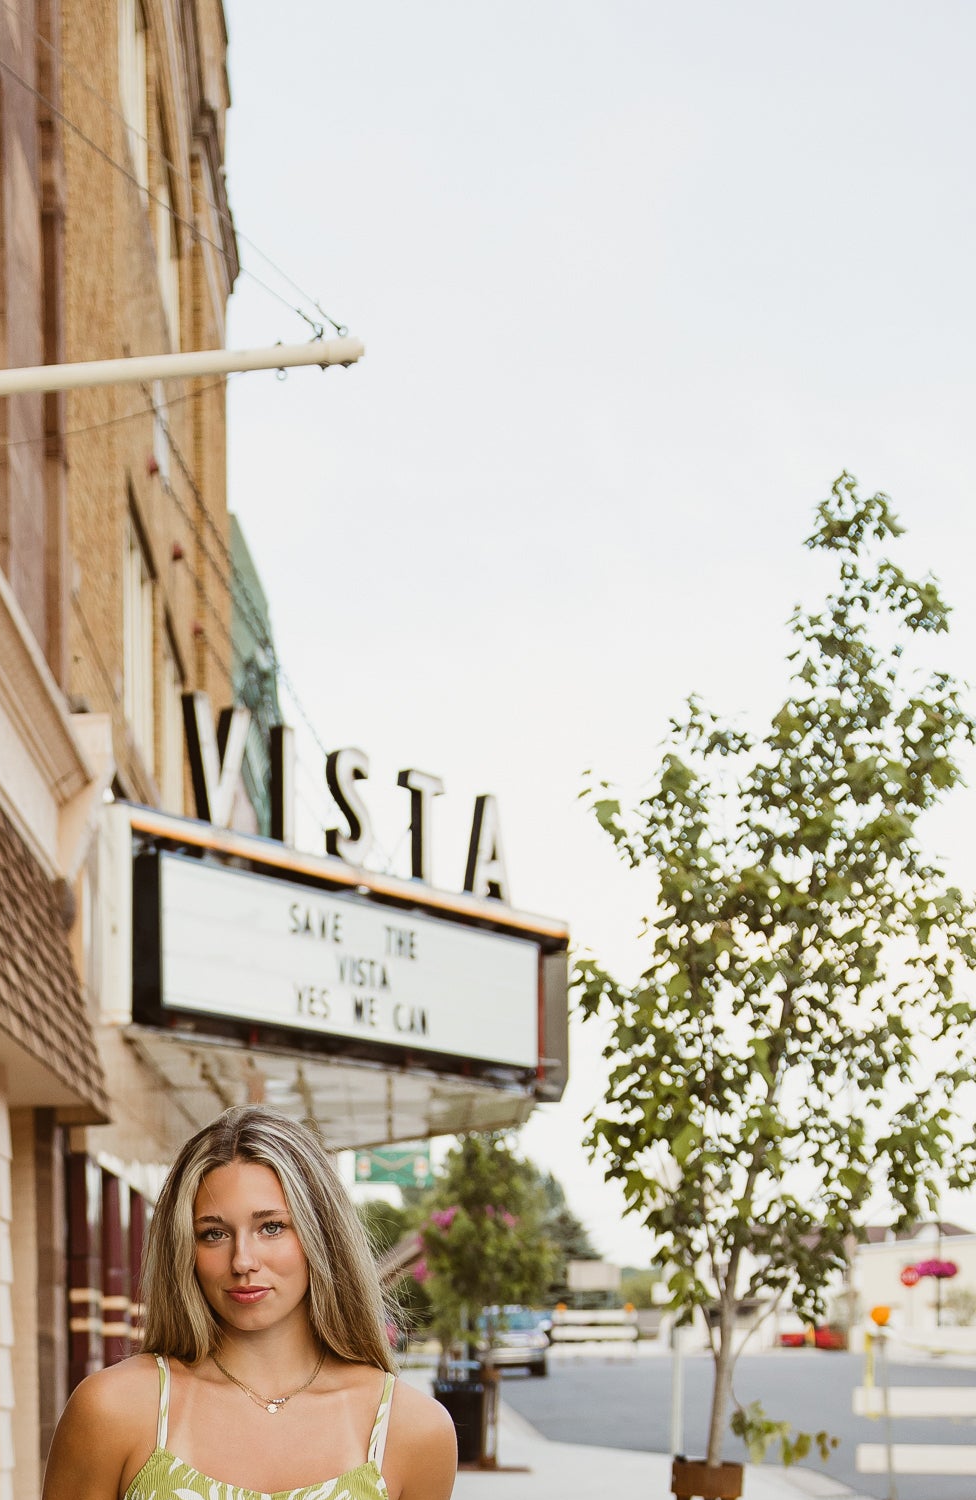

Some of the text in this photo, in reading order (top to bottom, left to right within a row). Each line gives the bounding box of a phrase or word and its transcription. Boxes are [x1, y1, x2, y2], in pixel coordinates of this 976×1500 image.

[181, 690, 510, 905] VISTA
[289, 903, 417, 959] SAVE THE
[336, 954, 391, 992] VISTA
[293, 983, 329, 1019] YES
[393, 1003, 429, 1036] CAN
